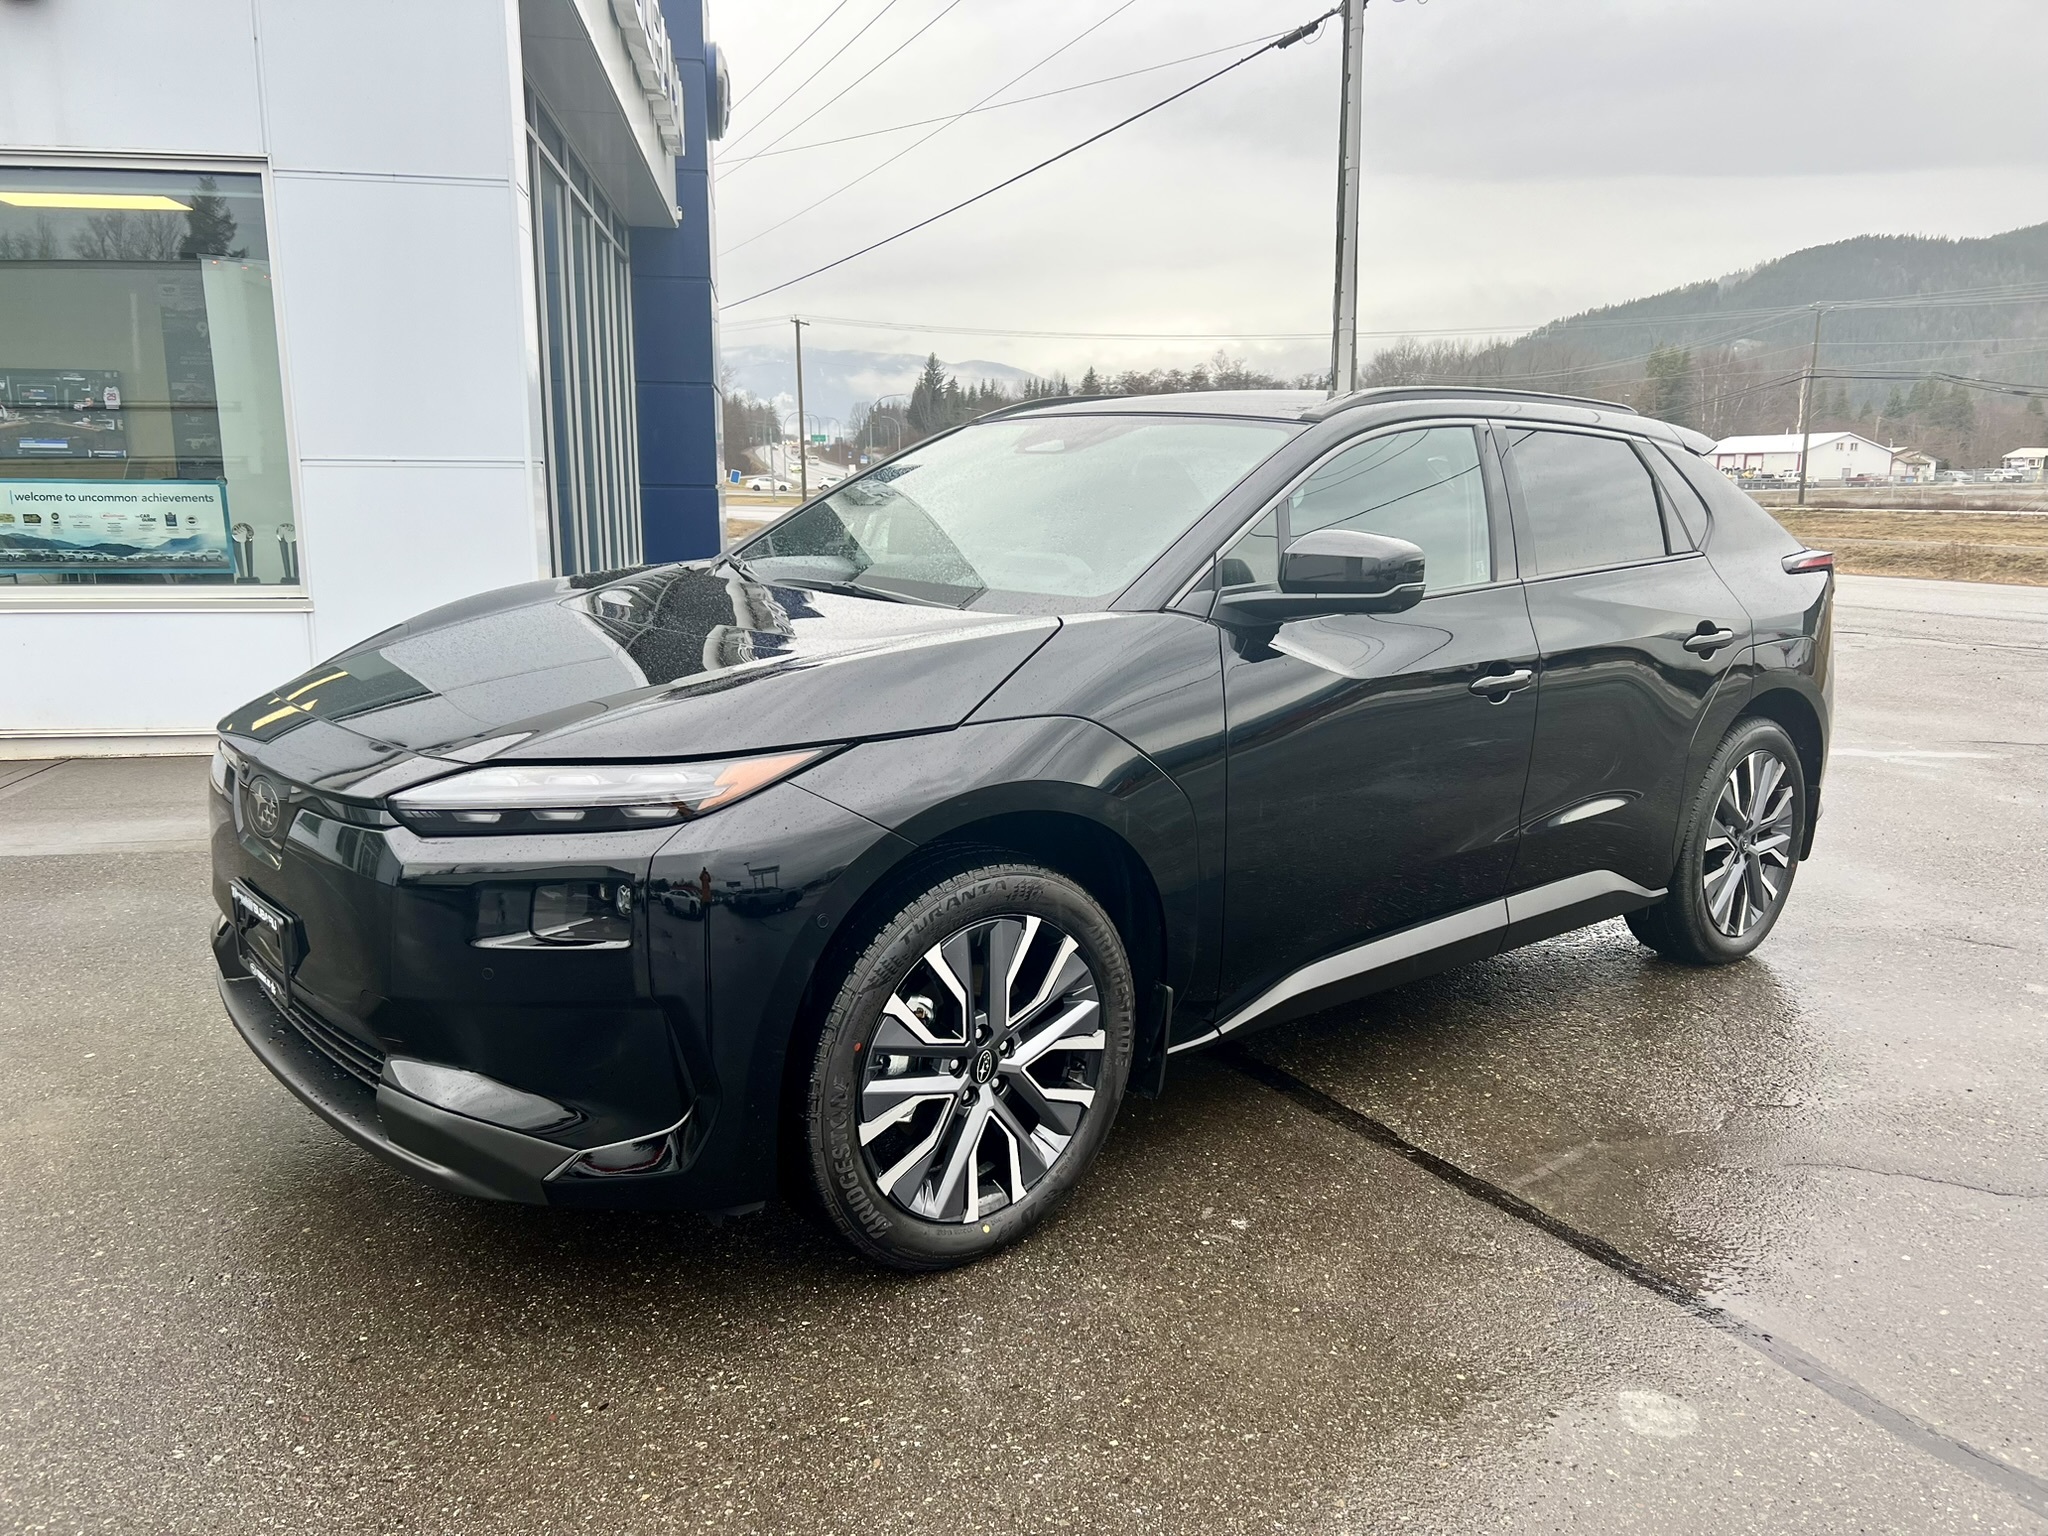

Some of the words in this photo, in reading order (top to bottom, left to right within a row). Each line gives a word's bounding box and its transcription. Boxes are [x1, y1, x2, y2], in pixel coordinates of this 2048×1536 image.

[14, 491, 62, 502] welcome
[64, 493, 76, 502] to
[78, 494, 138, 503] uncommon
[141, 492, 215, 503] achievements
[899, 879, 1007, 946] TURANZA
